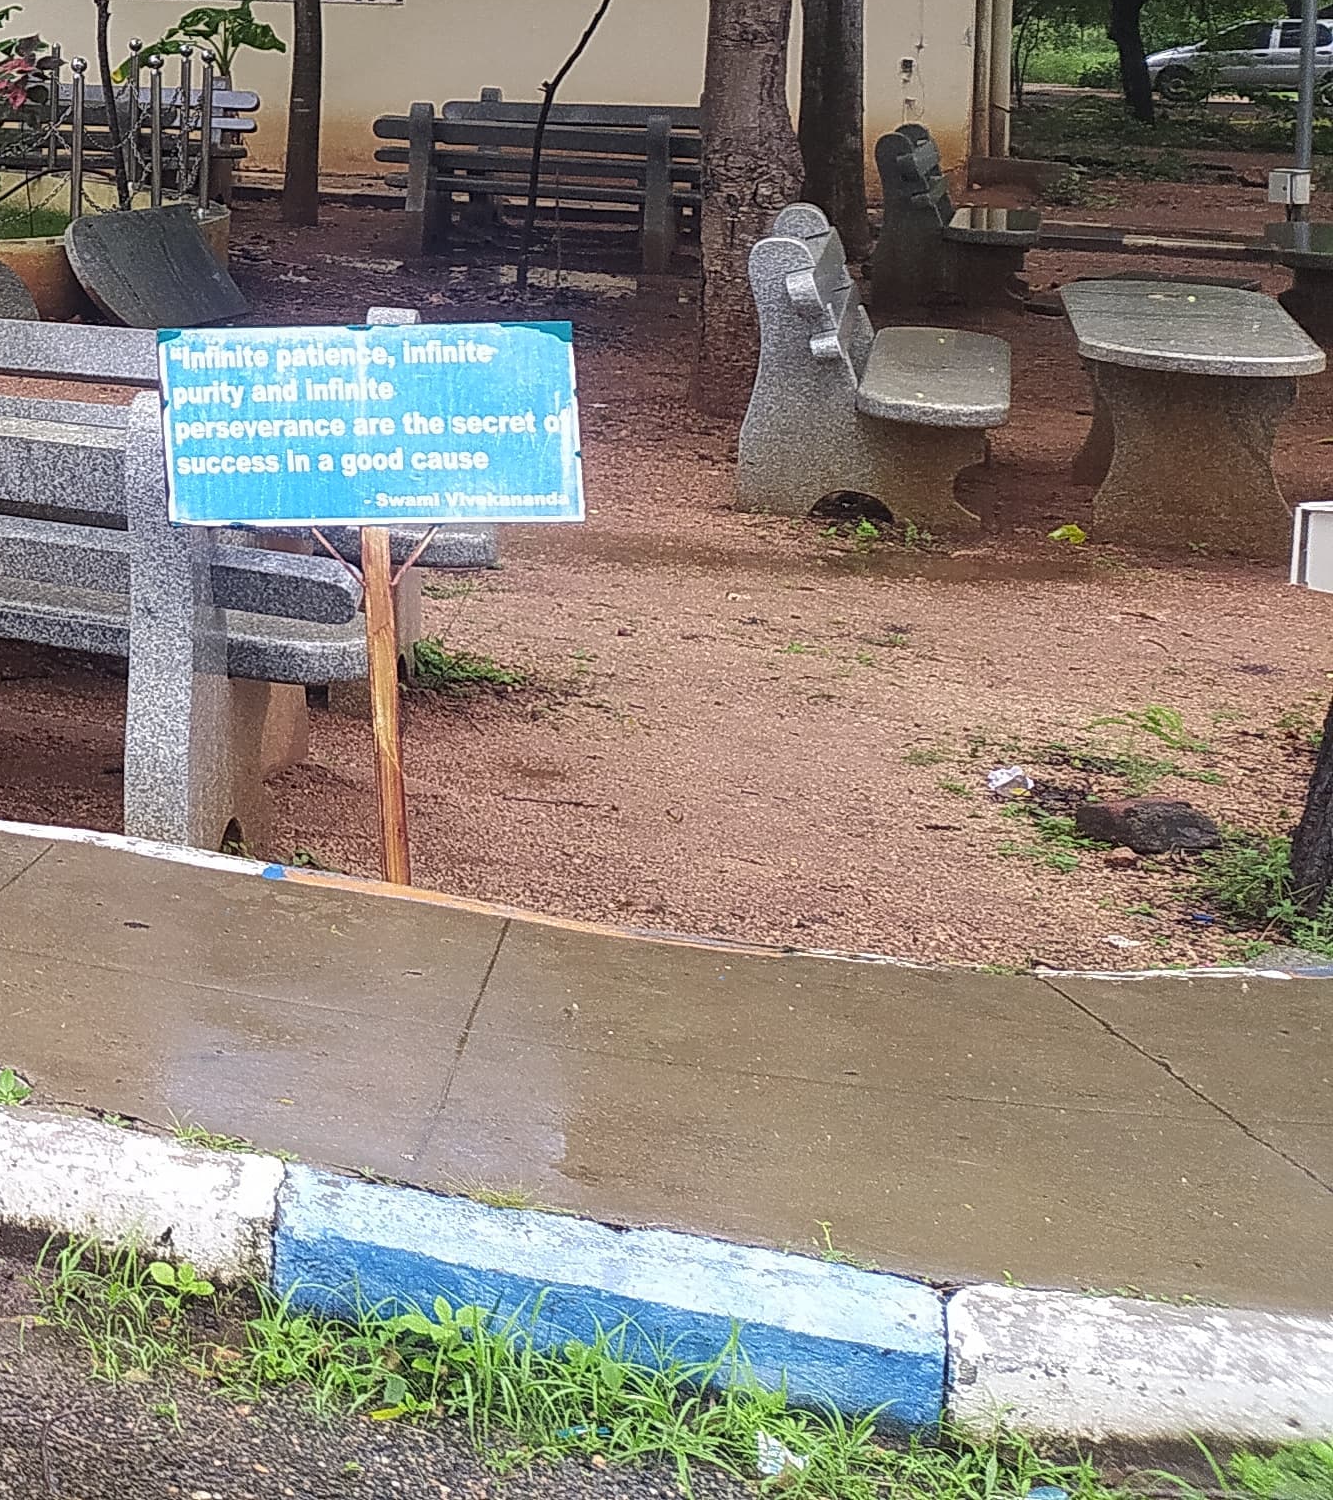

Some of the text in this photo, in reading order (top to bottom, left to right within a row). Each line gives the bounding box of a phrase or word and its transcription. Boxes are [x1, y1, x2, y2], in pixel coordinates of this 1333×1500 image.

[276, 344, 395, 372] patience,
[403, 340, 493, 364] infinite
[173, 378, 394, 409] purity and infinite
[175, 415, 346, 445] perseverance
[353, 415, 395, 436] are
[402, 411, 445, 435] the
[451, 410, 536, 435] secret
[177, 447, 489, 477] success in a good cause
[376, 492, 439, 507] Swami
[444, 490, 569, 507] Vivekananda
